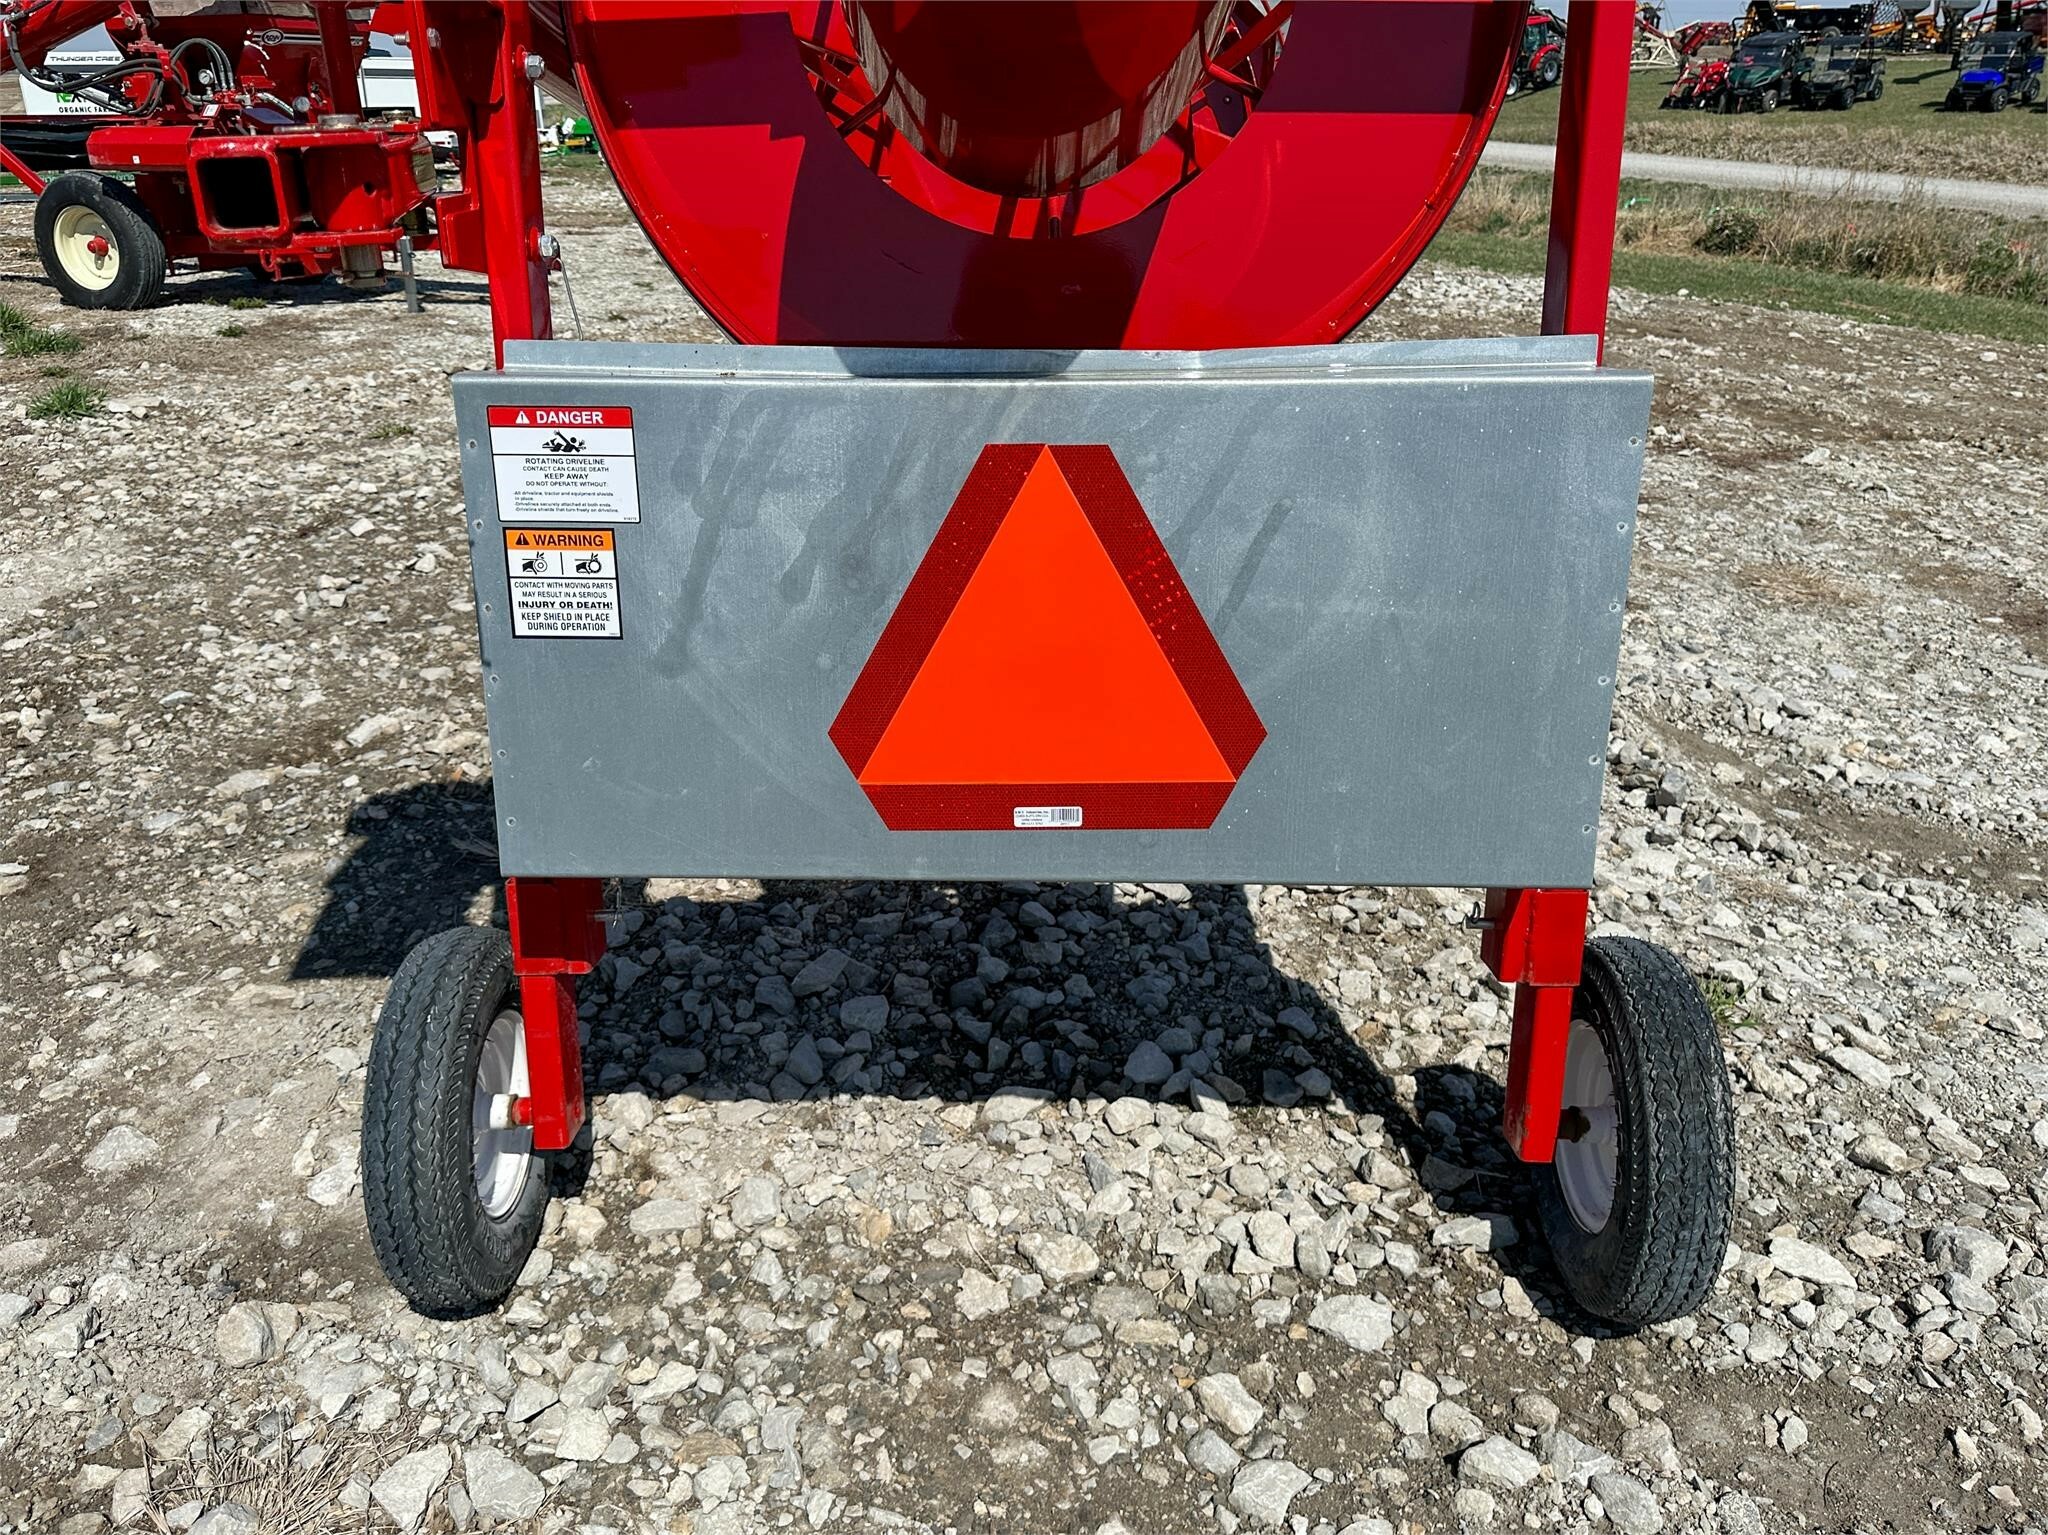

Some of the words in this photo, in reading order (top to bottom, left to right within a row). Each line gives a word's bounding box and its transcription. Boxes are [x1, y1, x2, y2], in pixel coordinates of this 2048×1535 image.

[535, 411, 603, 424] DANGER
[533, 534, 604, 547] WARNING
[518, 601, 556, 609] INJURY
[559, 601, 574, 609] OR
[576, 601, 613, 609] DEATH!
[521, 612, 542, 621] KEEP
[544, 613, 572, 621] SHIELD
[574, 613, 583, 621] IN
[585, 613, 611, 622] PLACE
[527, 622, 559, 631] DURING
[561, 622, 606, 632] OPERATION
